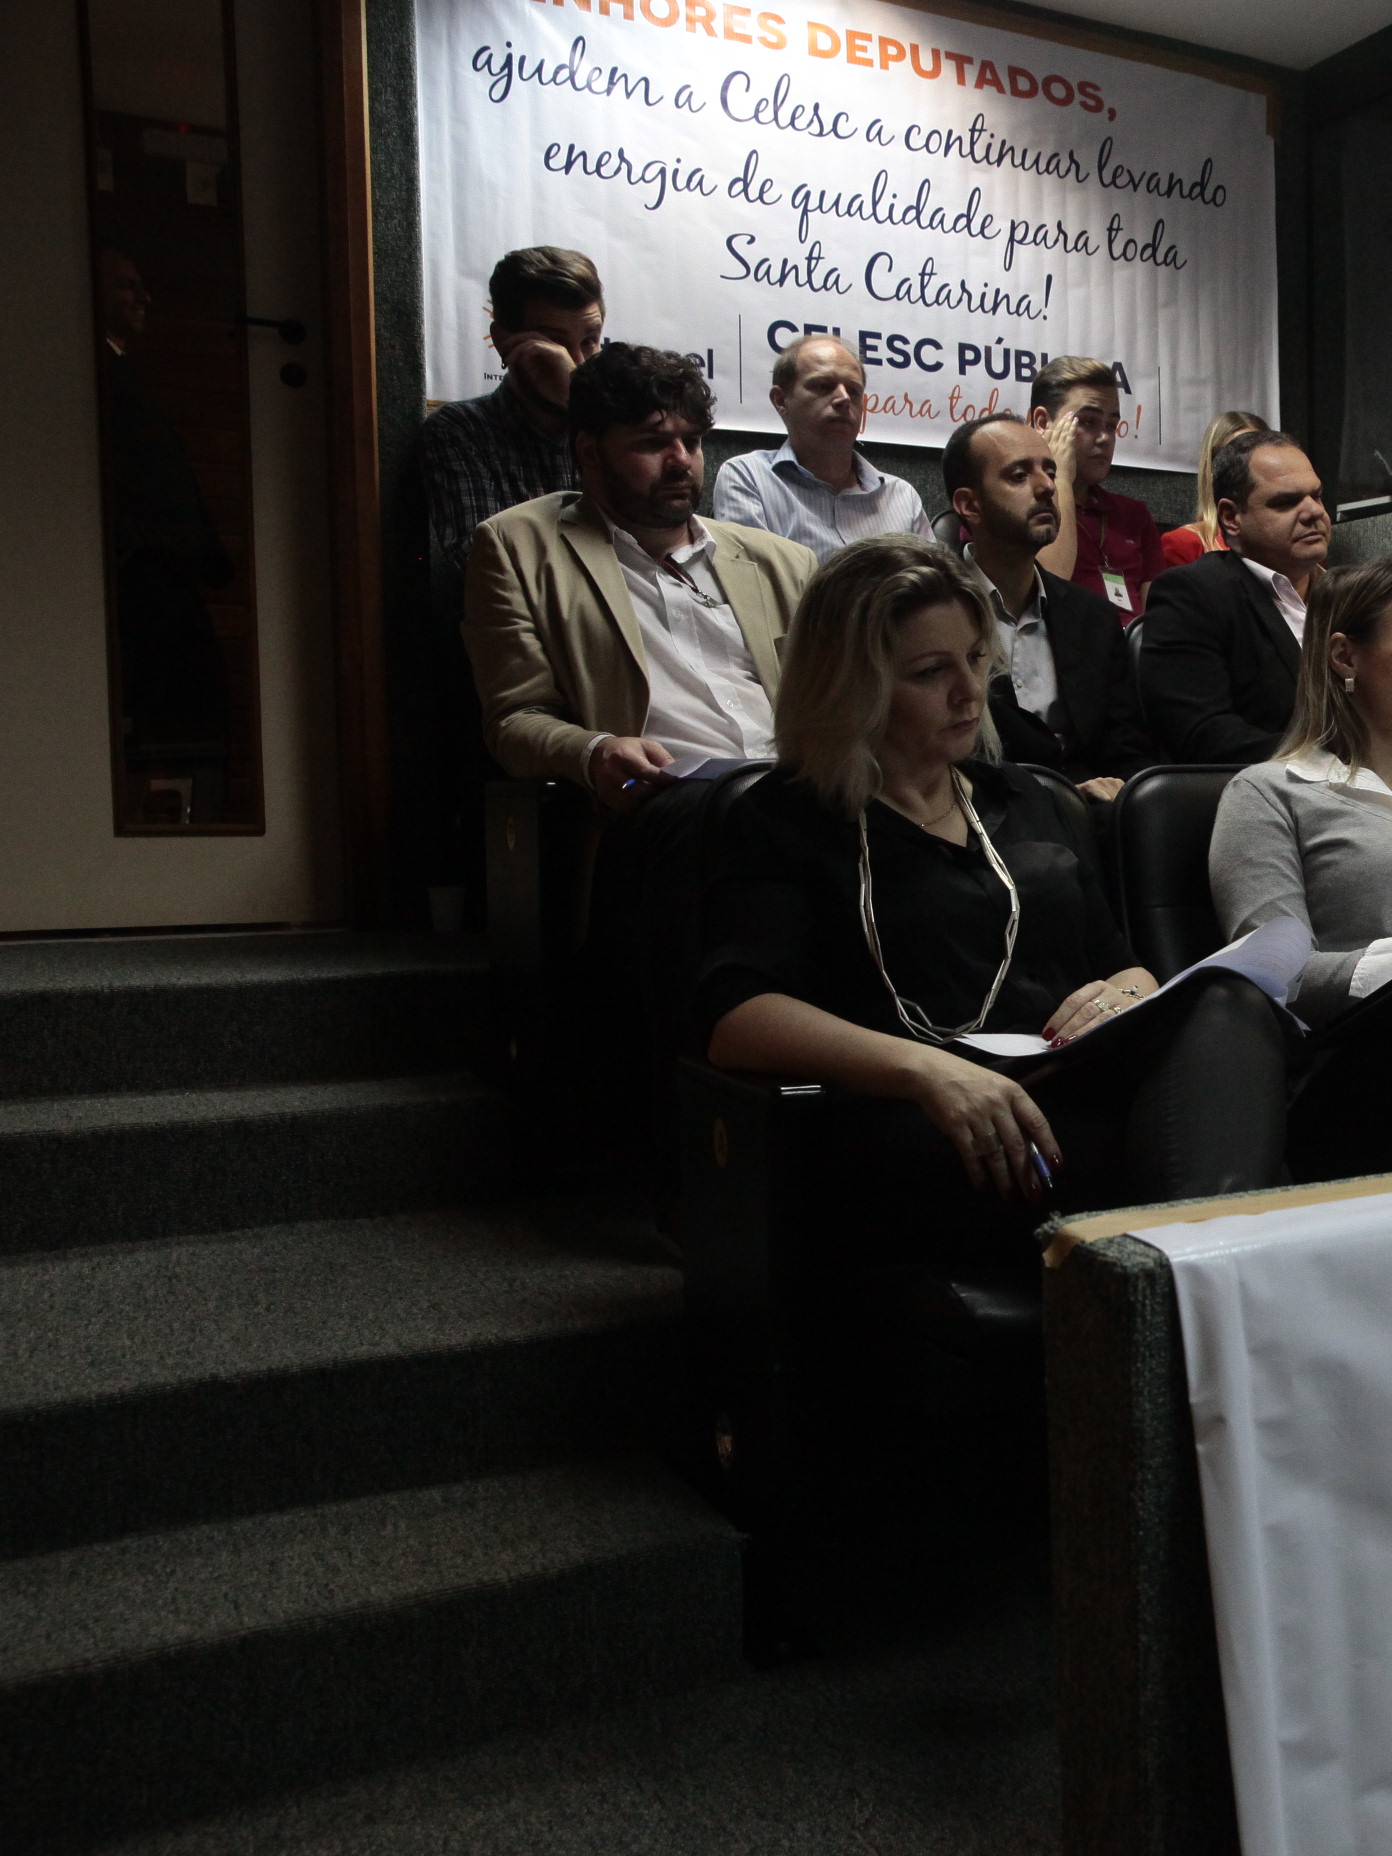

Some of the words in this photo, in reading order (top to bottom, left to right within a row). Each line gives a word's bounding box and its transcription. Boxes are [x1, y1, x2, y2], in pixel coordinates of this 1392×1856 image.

[808, 21, 1117, 122] DEPUTADOS,
[471, 36, 664, 104] ajudem
[674, 84, 706, 113] a
[719, 70, 858, 139] Celesc
[866, 118, 895, 147] a
[904, 113, 1090, 184] continuar
[1097, 136, 1227, 208] levando
[543, 142, 718, 210] energia
[727, 149, 782, 206] de
[790, 169, 1001, 244] qualidade
[1003, 218, 1100, 271] para
[1106, 213, 1188, 270] toda
[720, 232, 852, 295] Santa
[864, 251, 1053, 321] Catarina!
[860, 390, 940, 434] para
[949, 384, 1013, 424] tod
[958, 336, 1132, 396] PÚBA
